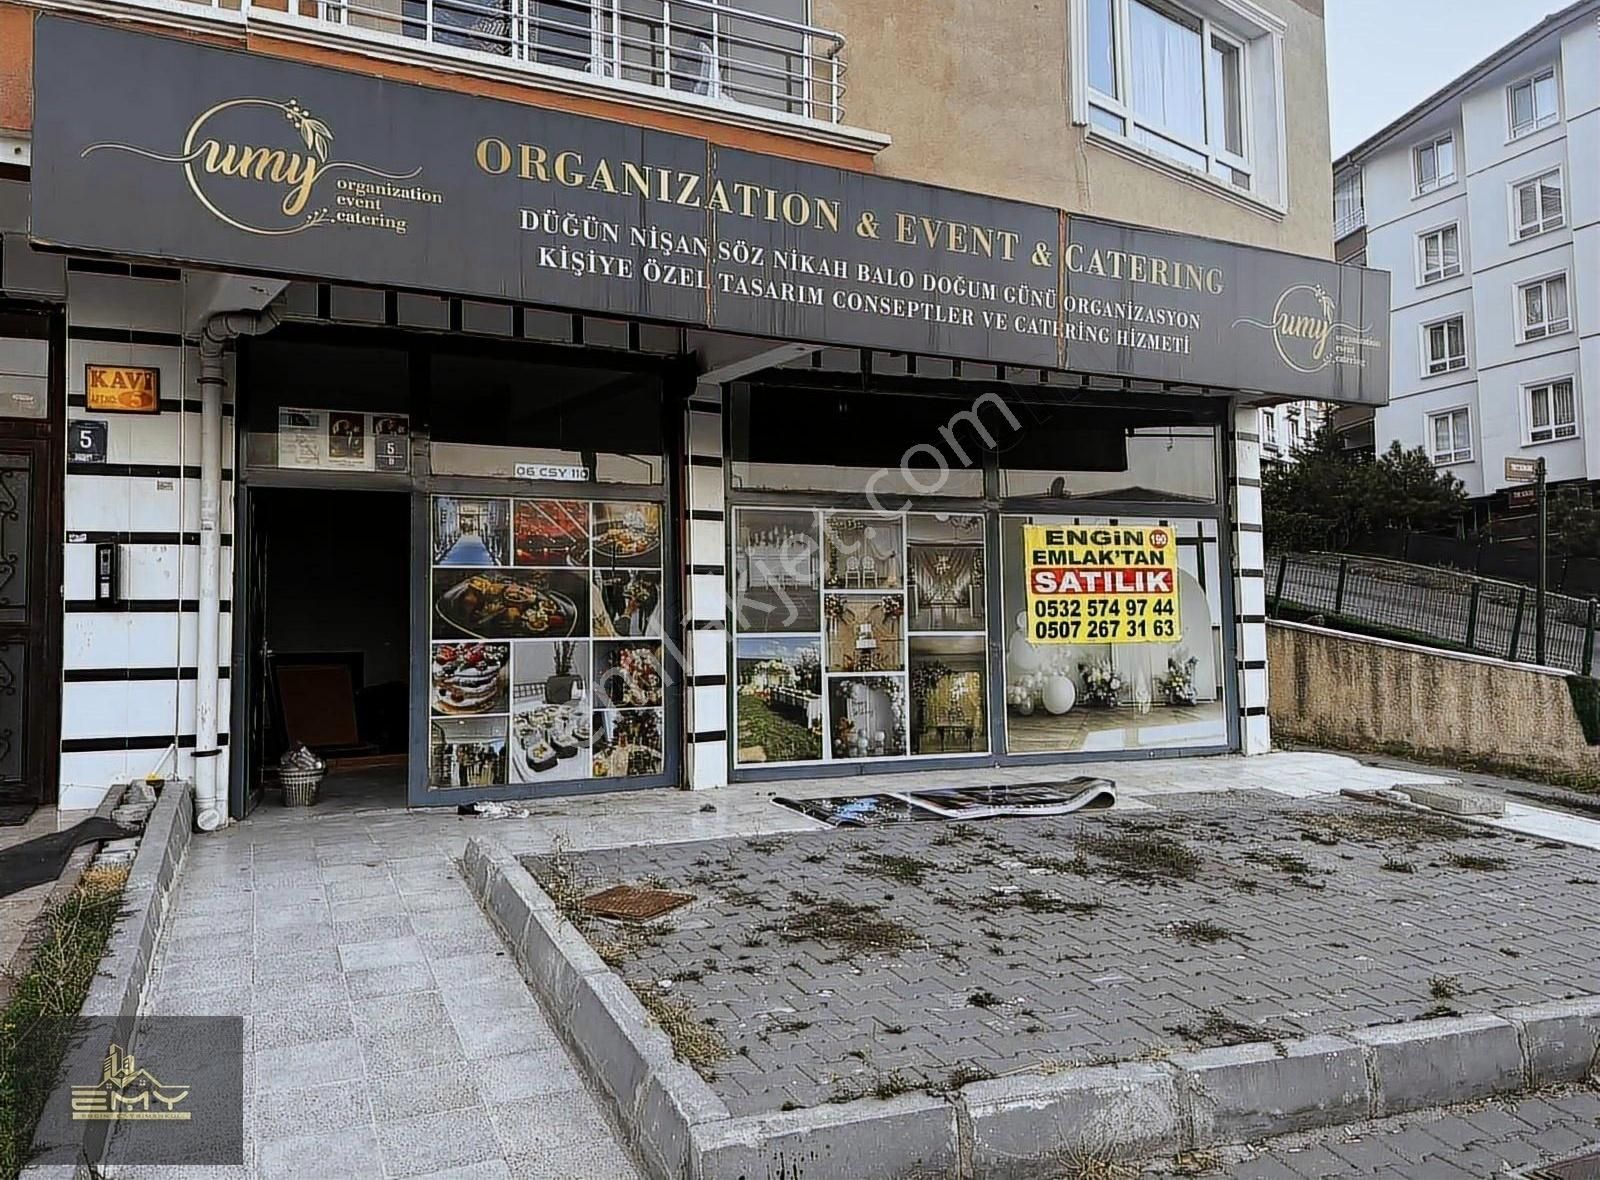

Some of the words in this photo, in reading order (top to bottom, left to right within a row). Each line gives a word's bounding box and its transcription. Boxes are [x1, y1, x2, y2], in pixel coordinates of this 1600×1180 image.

[336, 179, 443, 205] organization
[336, 194, 382, 211] event
[336, 209, 408, 234] catering
[475, 138, 840, 233] ORGANIZATION
[856, 211, 881, 240] &
[895, 213, 1020, 262] EVENT
[1031, 241, 1053, 267] &
[1065, 243, 1224, 295] CATERING
[519, 208, 620, 244] DÜĞÜN
[630, 224, 708, 258] NİŞAN
[718, 239, 765, 267] SÖZ
[773, 249, 850, 280] NİKAH
[857, 263, 915, 290] BALO
[923, 274, 998, 302] DOĞUM
[1003, 283, 1057, 310] GÜNÜ
[1063, 295, 1202, 331] ORGANİZASYON
[538, 245, 633, 278] KİŞİYE
[643, 258, 709, 290] ÖZEL
[718, 272, 824, 306] TASARIM
[833, 290, 974, 327] CONSEPTLER
[983, 311, 1008, 331] VE
[1117, 328, 1192, 354] HİZMETİ
[80, 430, 92, 449] 5
[387, 442, 395, 455] 5
[516, 466, 536, 476] 06
[539, 467, 568, 478] CSY
[1034, 570, 1170, 593] SATILIK
[1035, 600, 1081, 617] 0532
[1087, 599, 1120, 617] 574
[1126, 598, 1148, 616] 97
[1153, 598, 1174, 616] 44
[1035, 621, 1081, 639] 0507
[1087, 620, 1120, 638] 267
[1127, 620, 1146, 637] 31
[1153, 619, 1174, 637] 63
